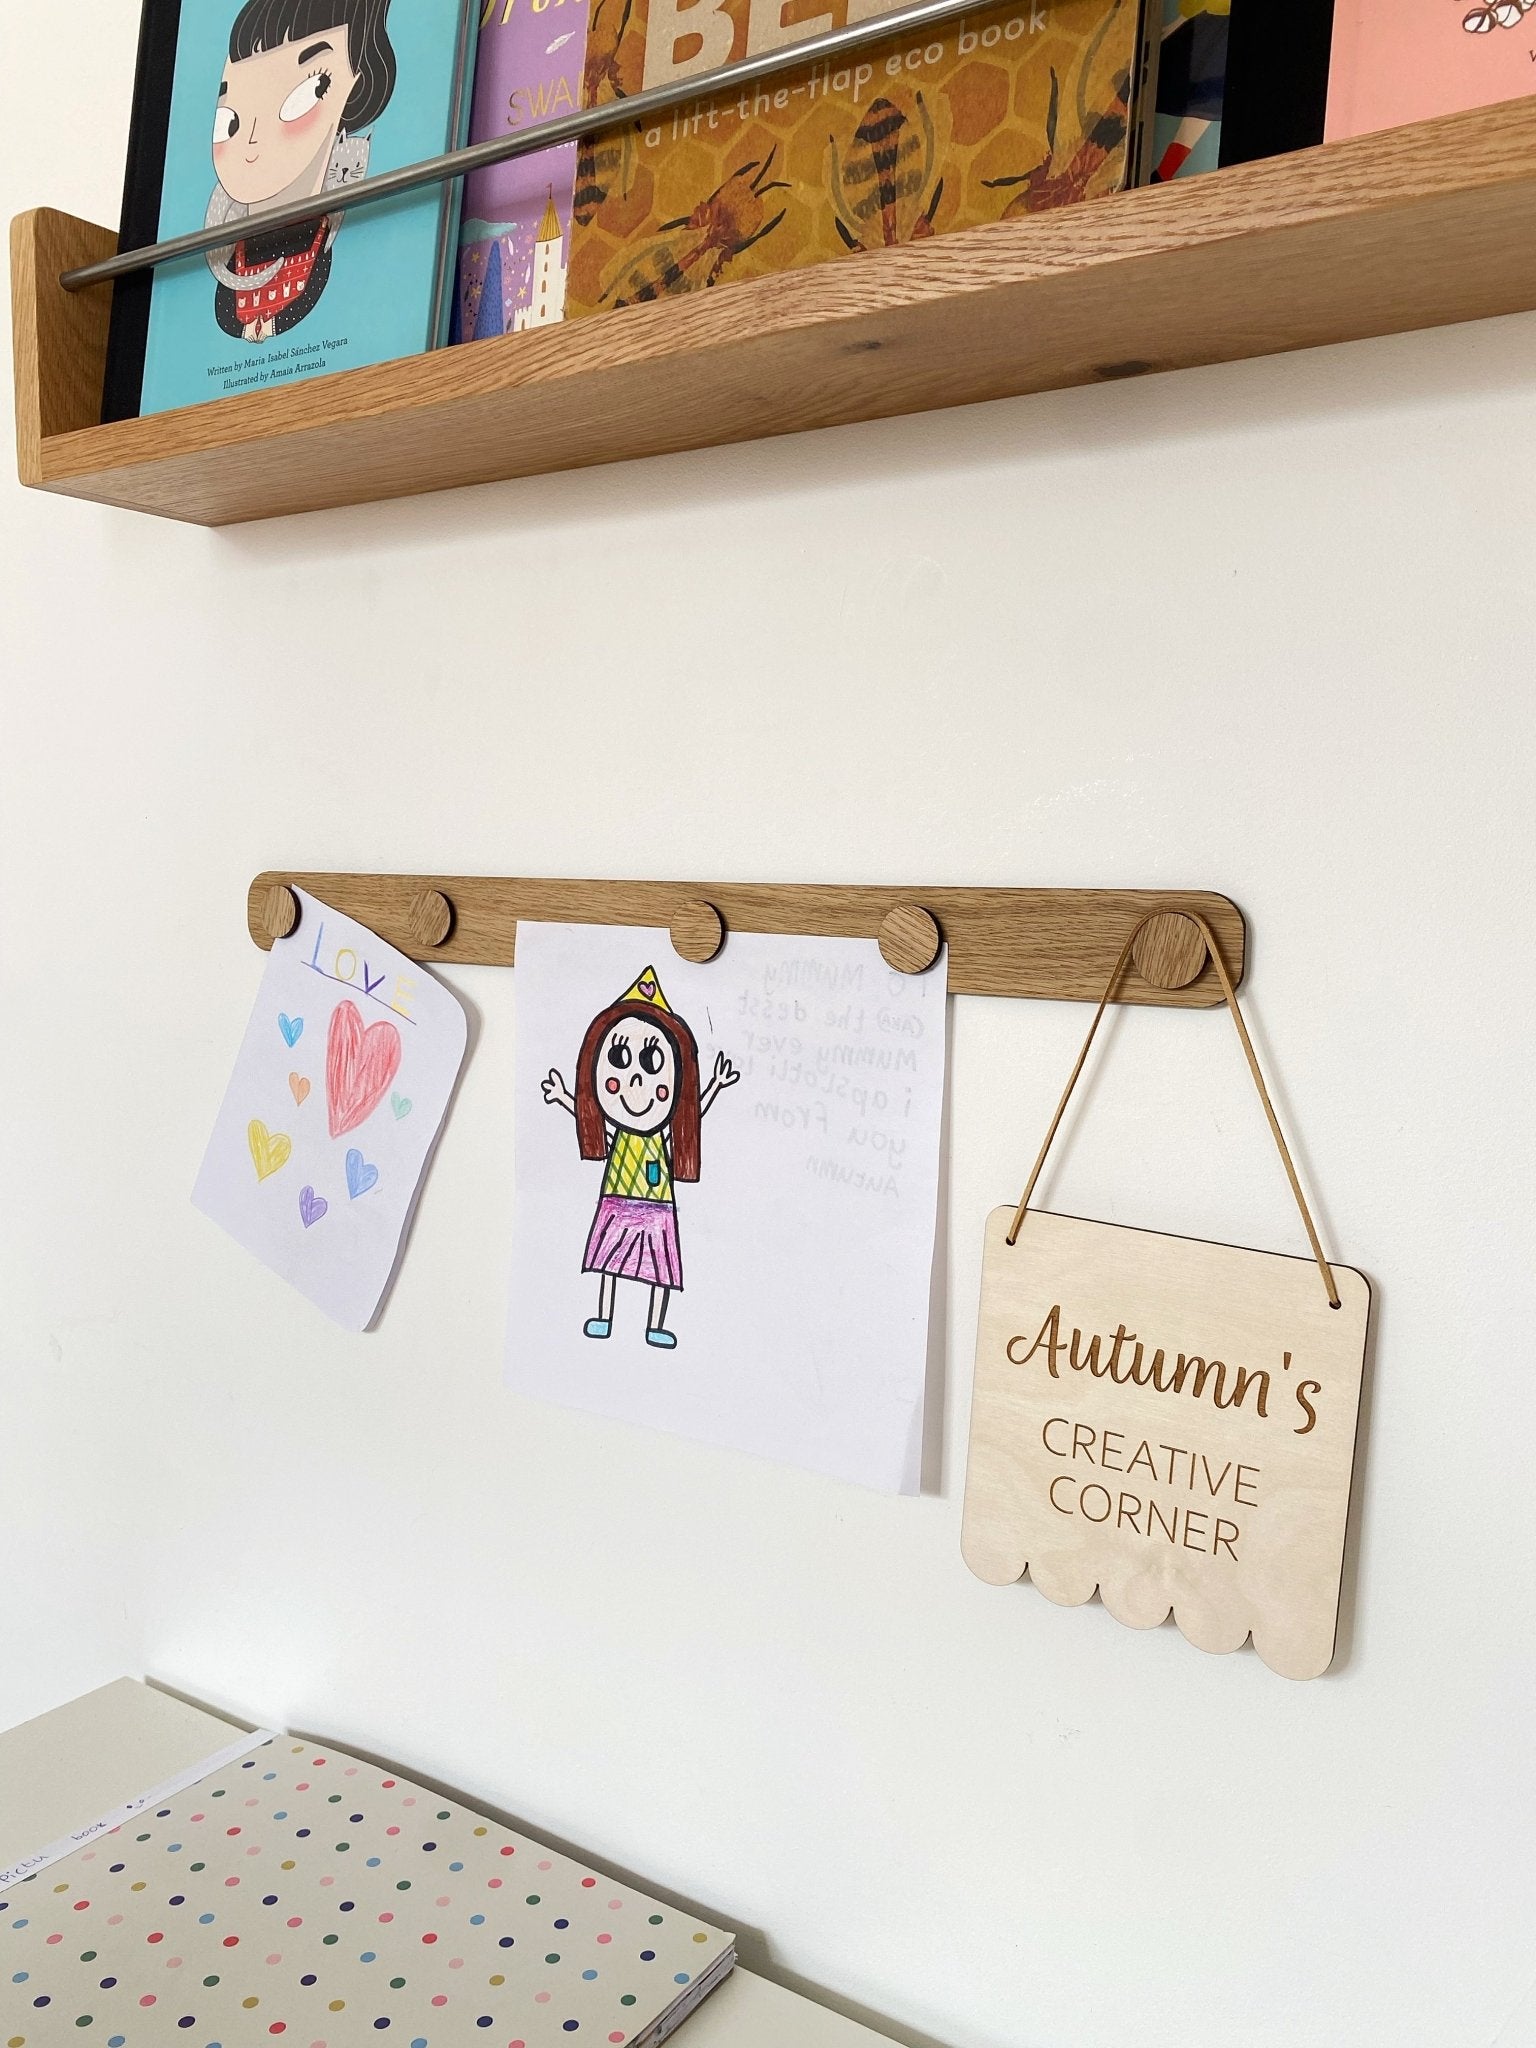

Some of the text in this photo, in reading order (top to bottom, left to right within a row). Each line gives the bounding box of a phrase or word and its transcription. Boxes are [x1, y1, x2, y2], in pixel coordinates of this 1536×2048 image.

[507, 70, 584, 126] SWA
[644, 3, 1049, 148] a lift-the-flap eco book
[207, 364, 233, 377] Written
[234, 360, 243, 373] by
[244, 357, 265, 369] Maria
[267, 348, 289, 363] Isabel
[322, 337, 348, 350] Vegara
[223, 357, 326, 390] Illustrated by Amaia Arrazola
[310, 921, 417, 1017] LOVE
[1006, 1305, 1322, 1434] Autumn's
[1042, 1417, 1260, 1508] CREATIVE
[1049, 1475, 1240, 1562] CORNER
[71, 1821, 107, 1841] book
